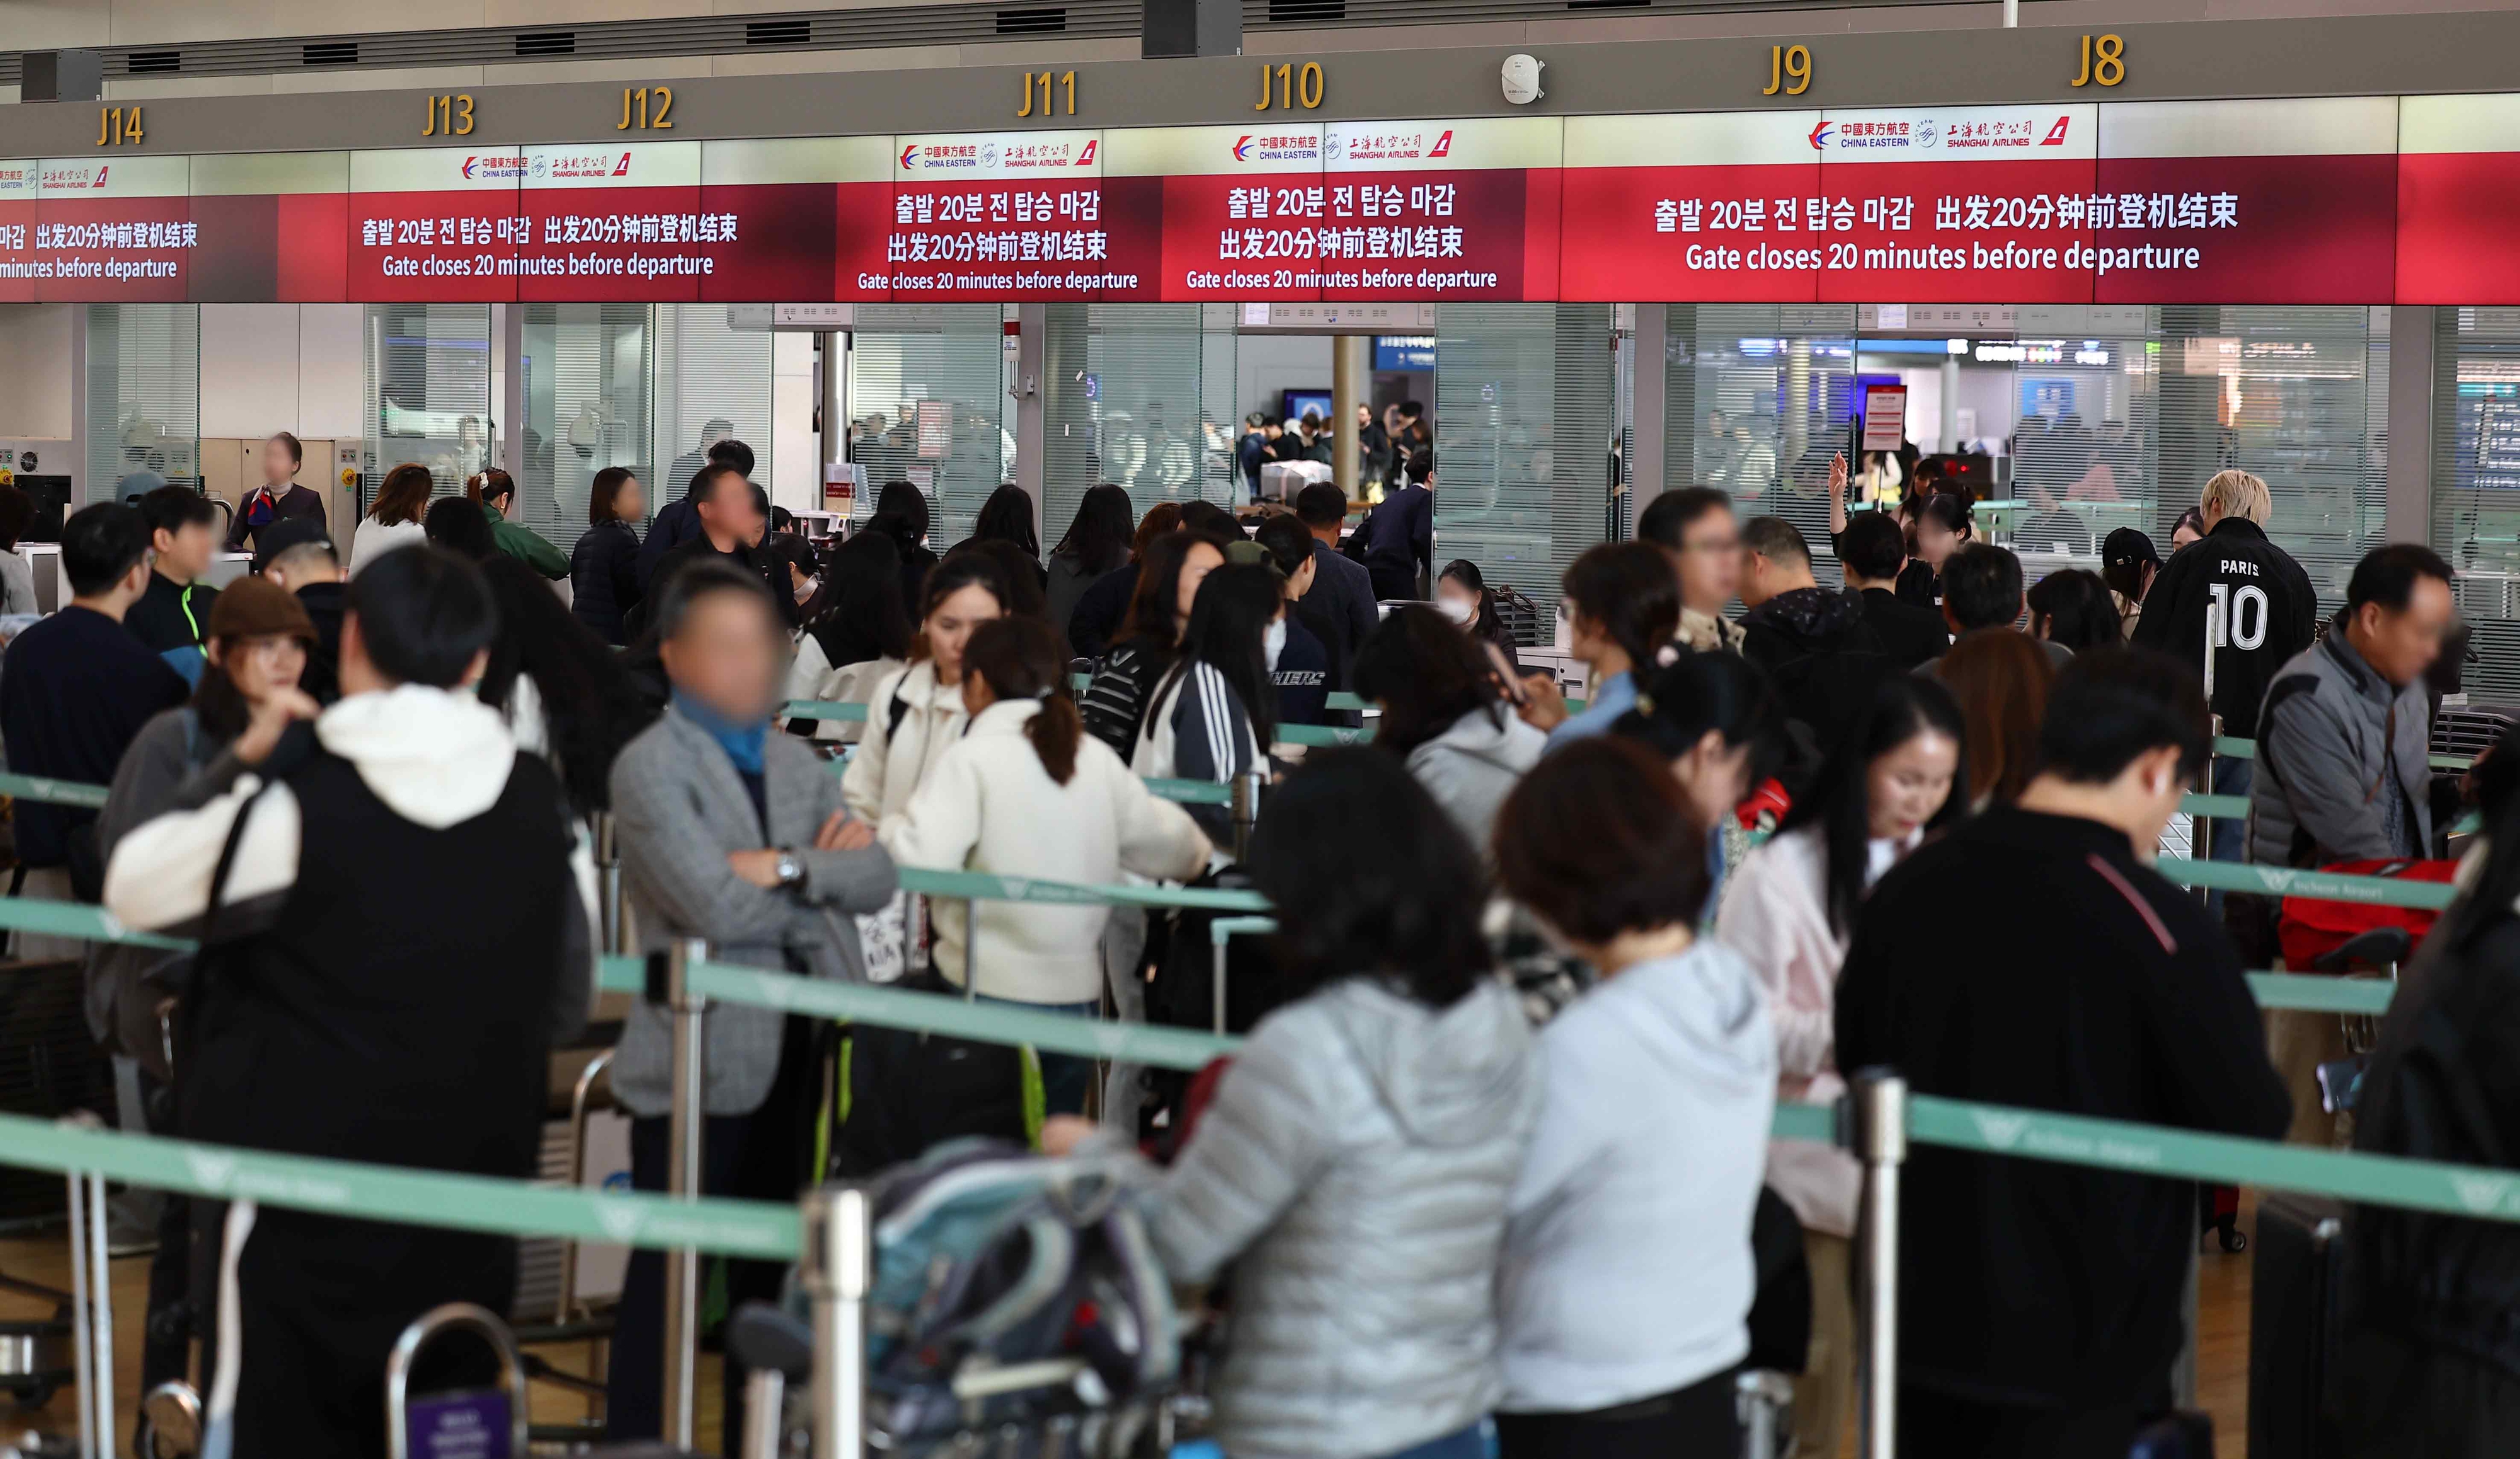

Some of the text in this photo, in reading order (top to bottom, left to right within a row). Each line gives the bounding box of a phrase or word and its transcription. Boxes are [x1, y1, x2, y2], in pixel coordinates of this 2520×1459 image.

[1763, 45, 1811, 95] J9
[2071, 34, 2124, 86] J8
[1018, 71, 1074, 117] J11
[1256, 62, 1323, 110] J10
[423, 94, 473, 135] J13
[617, 87, 671, 129] J12
[97, 107, 143, 146] J14
[1841, 122, 1909, 136] 中國東方航空
[925, 146, 976, 157] 中國東方航空
[1260, 137, 1317, 149] 中國東方航空
[1260, 151, 1317, 160] CHINA EASTERN
[1841, 137, 1909, 147] CHINA EASTERN
[1947, 138, 2030, 147] SHANGHAI AIRLINES
[483, 157, 528, 169] 中國東方航空
[946, 159, 976, 168] EASTERN
[896, 190, 1099, 223] 출발 20분 전 탑승 마감
[1228, 184, 1455, 218] 출발 20분 전 탑승 마감
[1655, 196, 1914, 232] 출발 20분 전 탑승 마감
[1936, 192, 2238, 230] 出发20分钟前登机结束
[0, 224, 26, 249] 마감
[37, 222, 197, 249] 出发20分钟前登机结束
[363, 217, 531, 245] 출발 20분 전 탑승 마감
[546, 213, 737, 243] 出发20分钟前登机结束
[1220, 226, 1463, 259] 出发20分钟前登机结束
[888, 230, 1107, 262] 出发20分钟前登机结束
[1687, 241, 2199, 275] Gate closes 20 minutes before departure
[0, 257, 176, 282] minutes before departure
[383, 253, 713, 280] Gate closes 20 minutes before departure
[1187, 268, 1496, 291] Gate closes 20 minutes before departure
[859, 271, 1137, 292] Gate closes 20 minutes before departure
[2221, 560, 2259, 576] PARIS
[2210, 583, 2268, 650] 10
